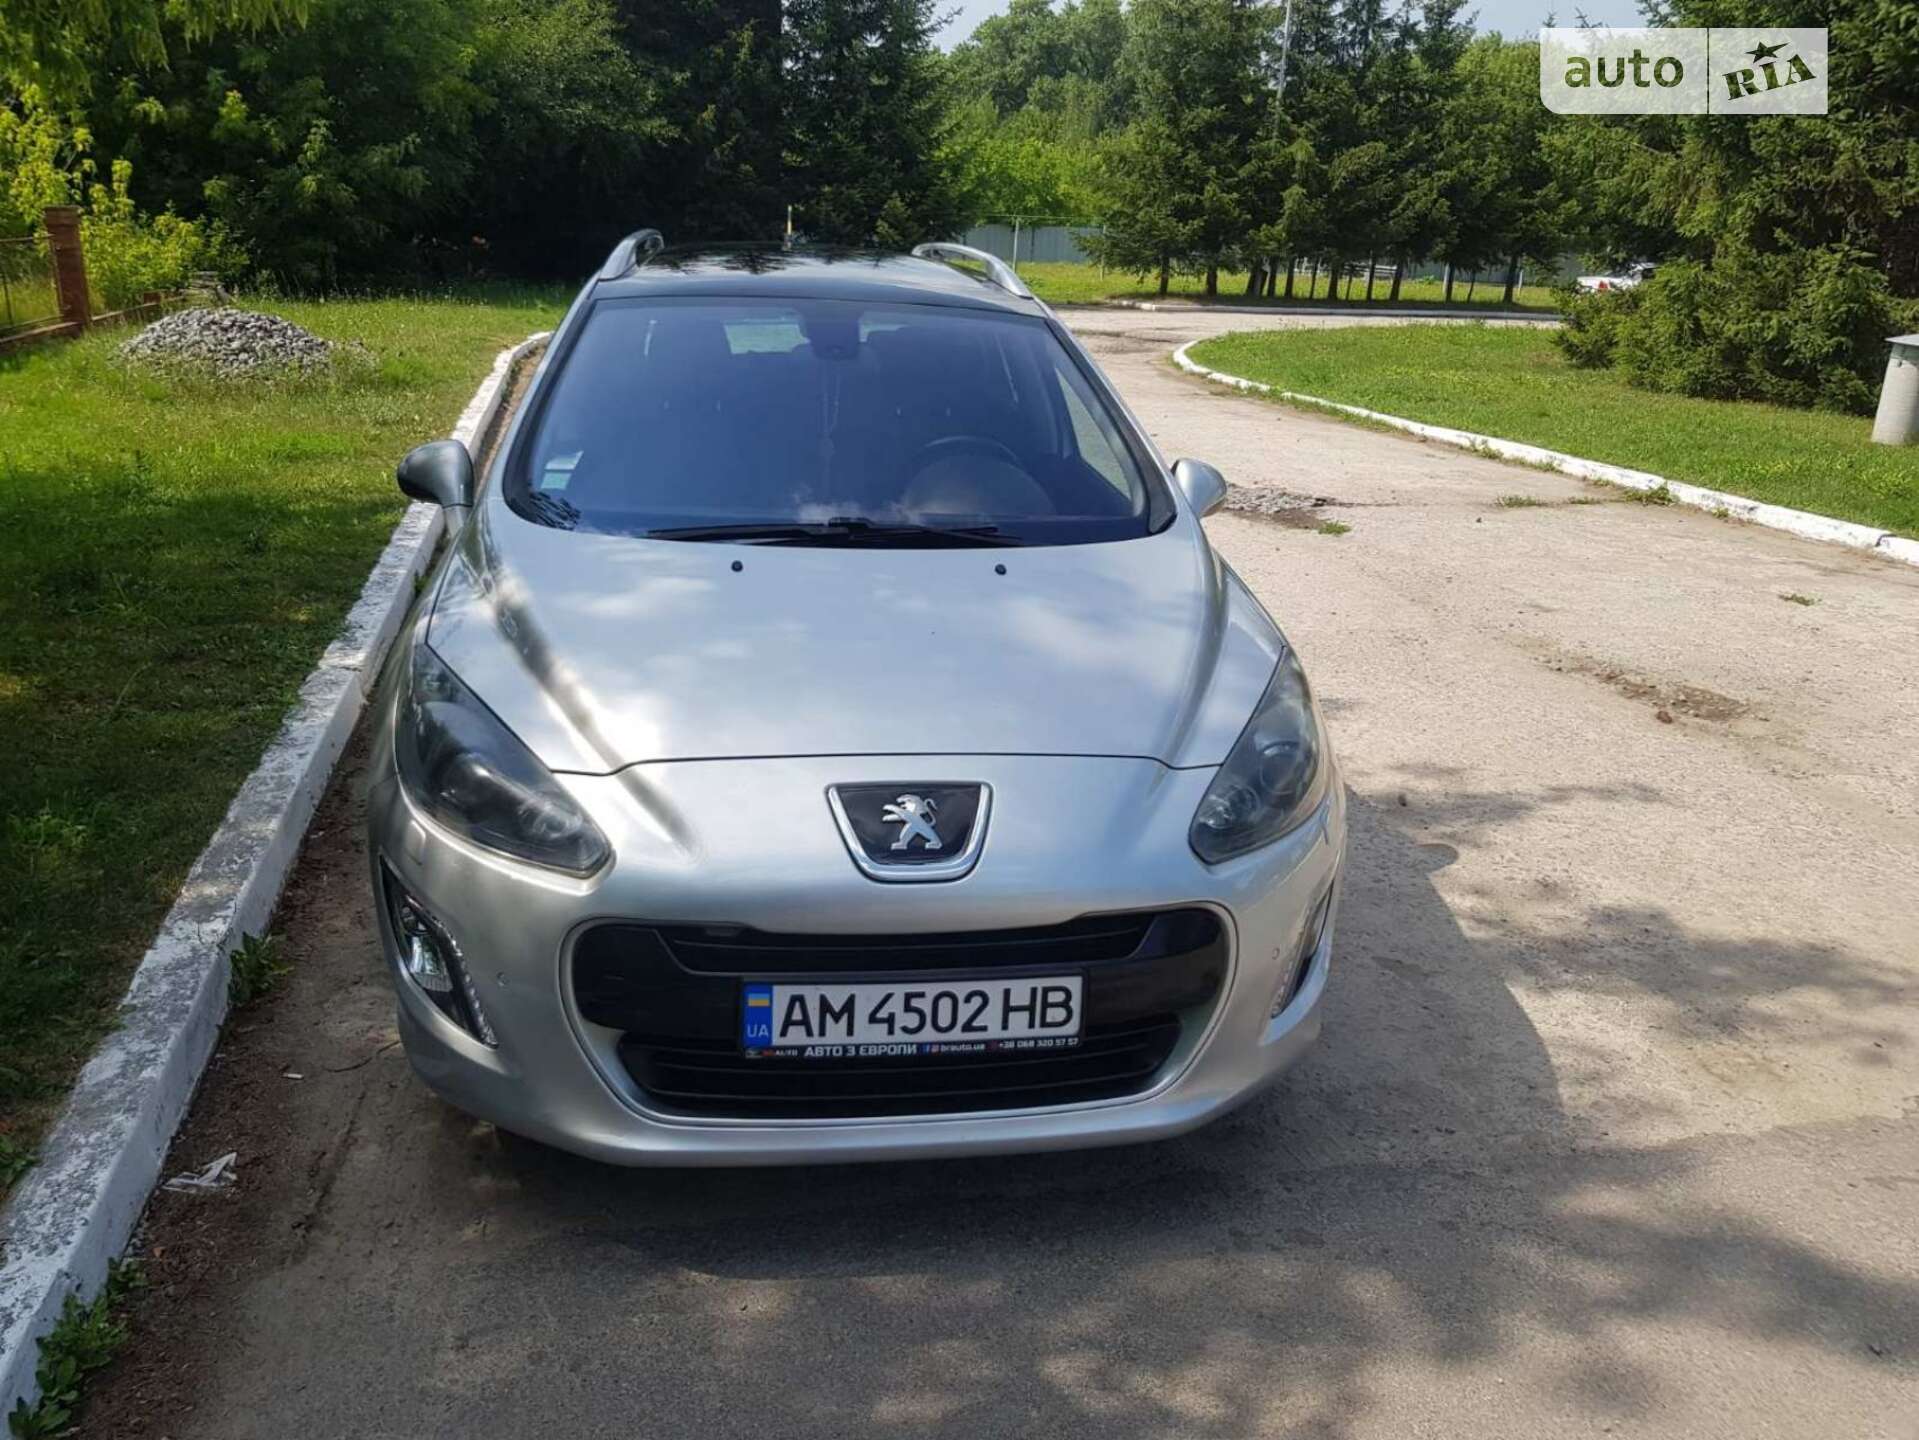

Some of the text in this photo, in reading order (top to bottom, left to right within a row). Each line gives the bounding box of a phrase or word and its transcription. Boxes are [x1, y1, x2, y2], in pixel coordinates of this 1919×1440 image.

[780, 985, 1074, 1038] AM 4502 HB
[747, 1025, 769, 1038] UA
[804, 1046, 843, 1057] АВТО
[859, 1044, 917, 1056] ЄВРОПИ
